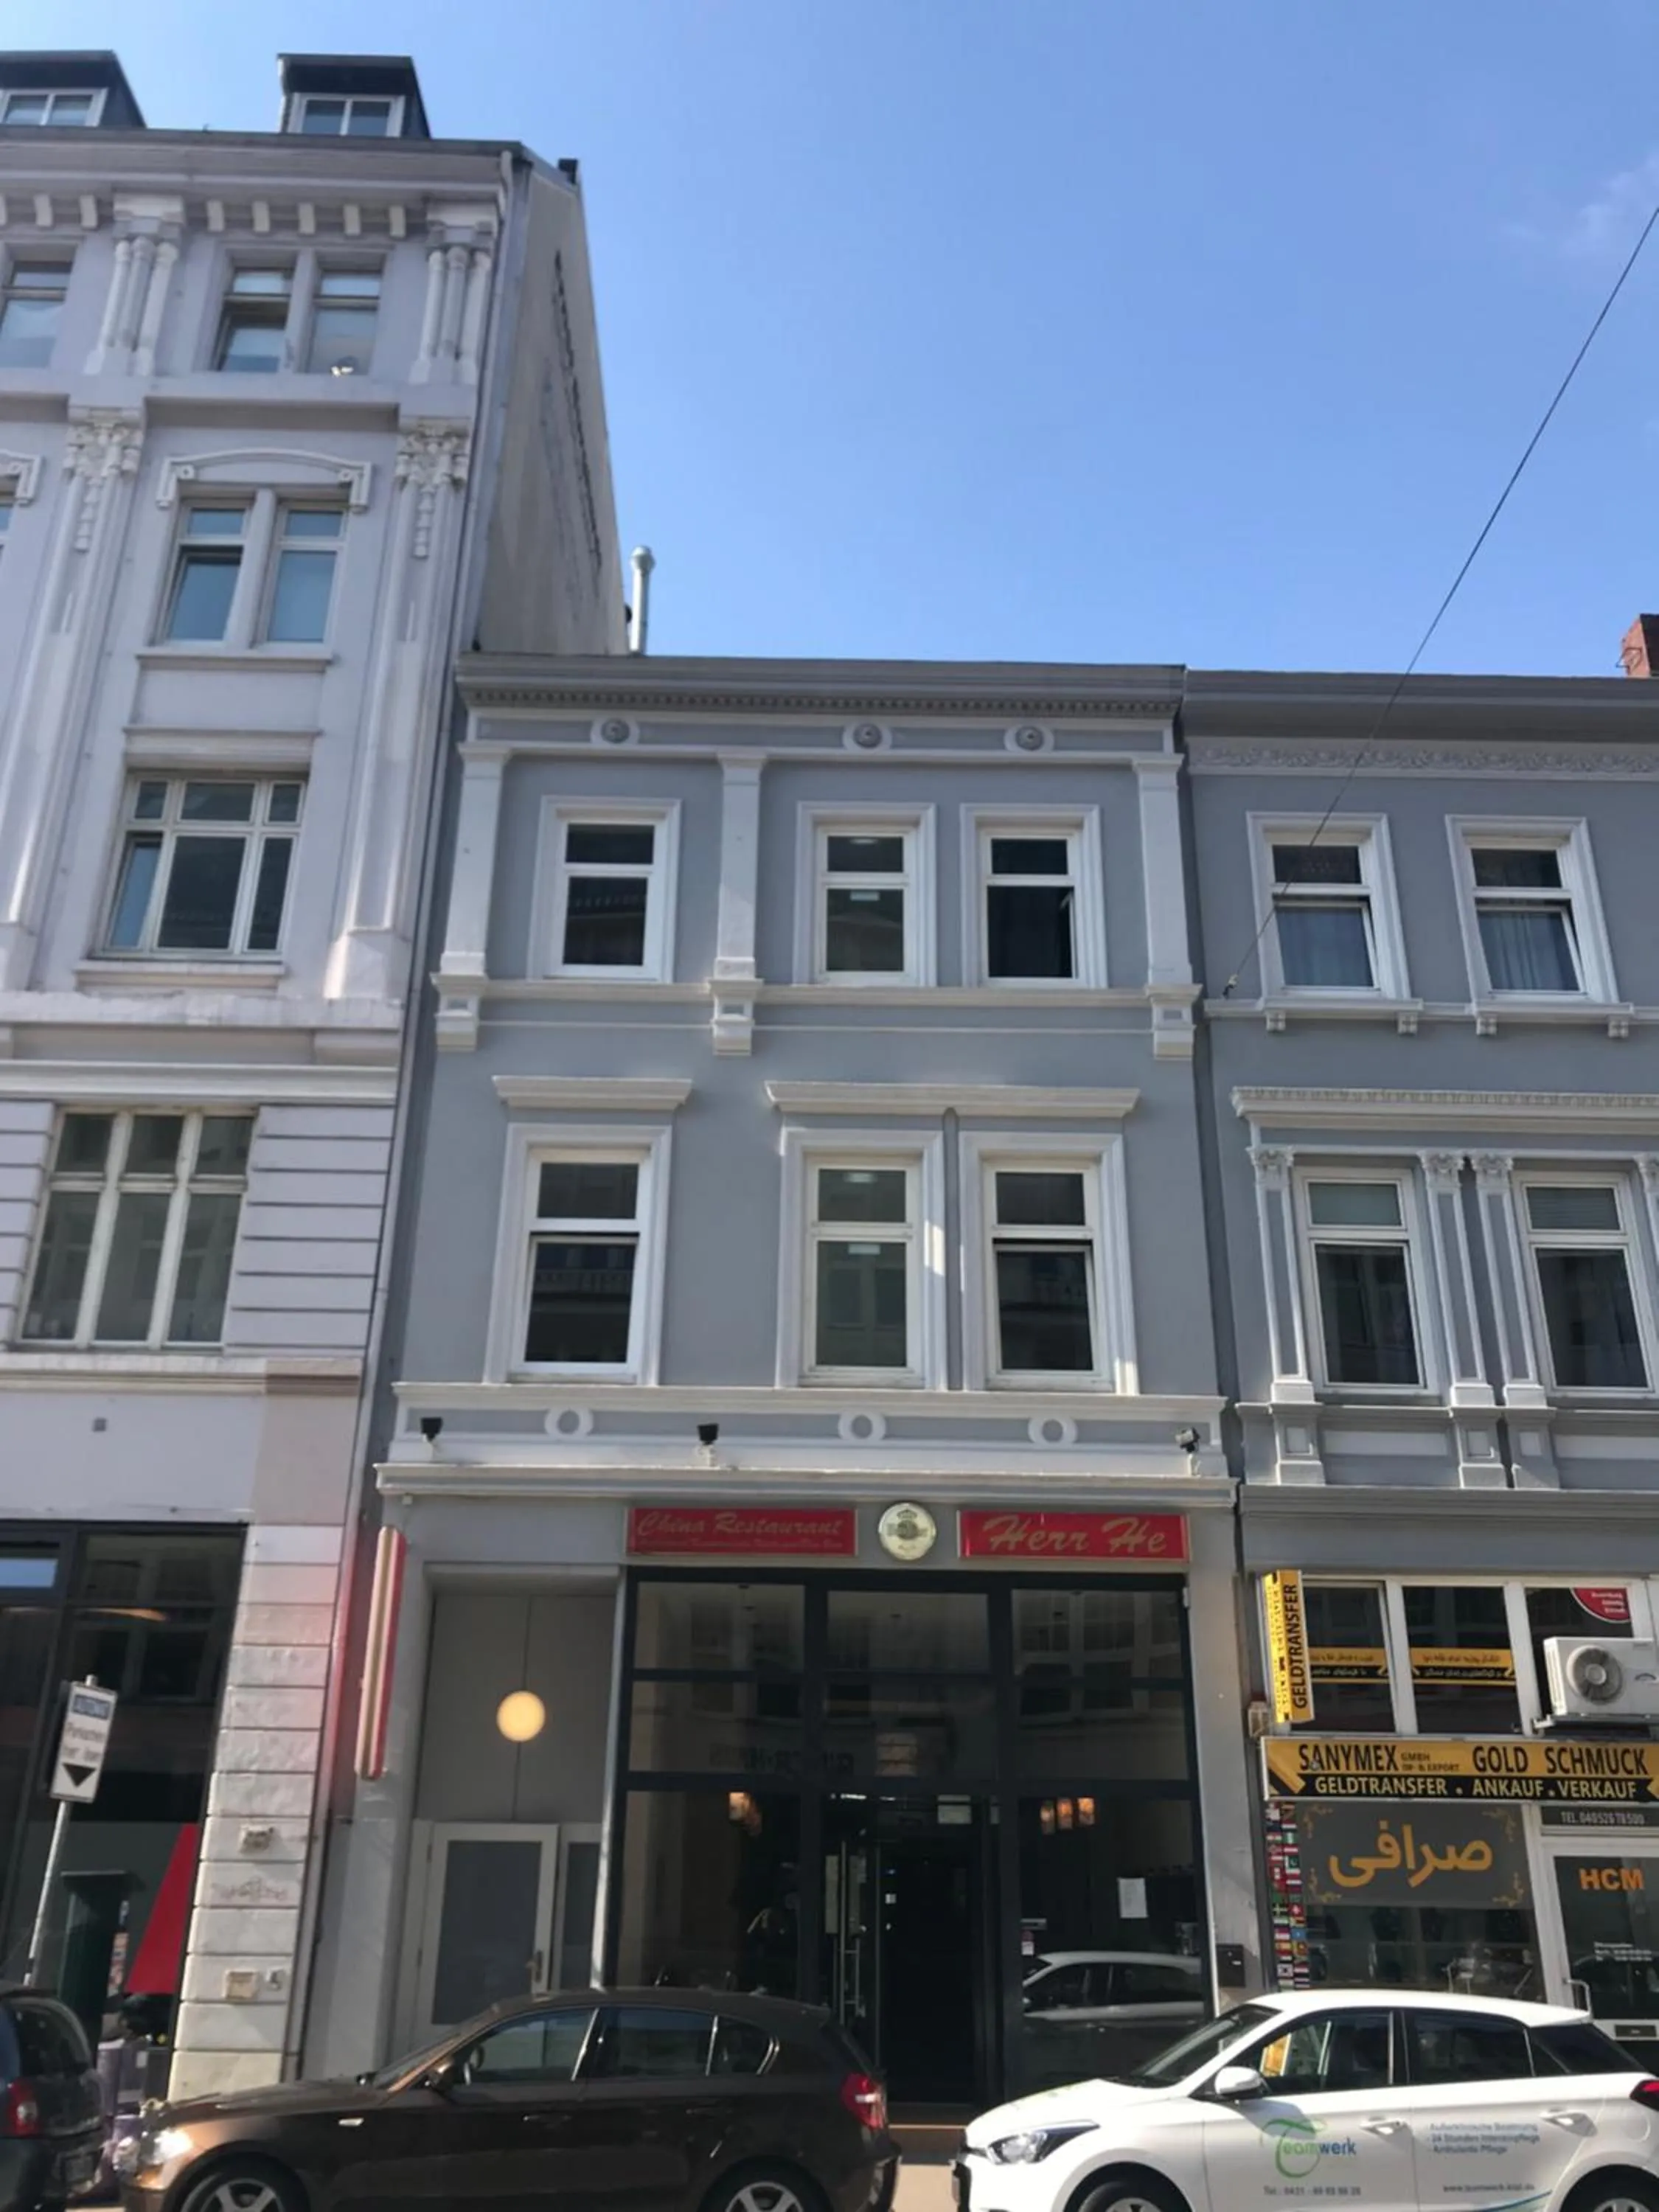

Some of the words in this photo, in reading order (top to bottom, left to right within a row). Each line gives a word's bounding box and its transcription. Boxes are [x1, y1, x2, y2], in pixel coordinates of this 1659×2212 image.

[637, 1511, 706, 1536] China
[713, 1512, 844, 1536] Restaurant
[982, 1514, 1089, 1551] Herr
[1100, 1516, 1167, 1554] He
[1283, 1584, 1309, 1709] GELDTRANSFER
[1298, 1743, 1399, 1771] SANYMEX
[1472, 1745, 1528, 1773] GOLD
[1544, 1746, 1649, 1775] SCHMUCK
[1315, 1775, 1448, 1795] GELDTRANSFER
[1472, 1778, 1544, 1798] ANKAUF
[1557, 1780, 1637, 1799] VERKAUF
[1579, 1868, 1645, 1891] HCM
